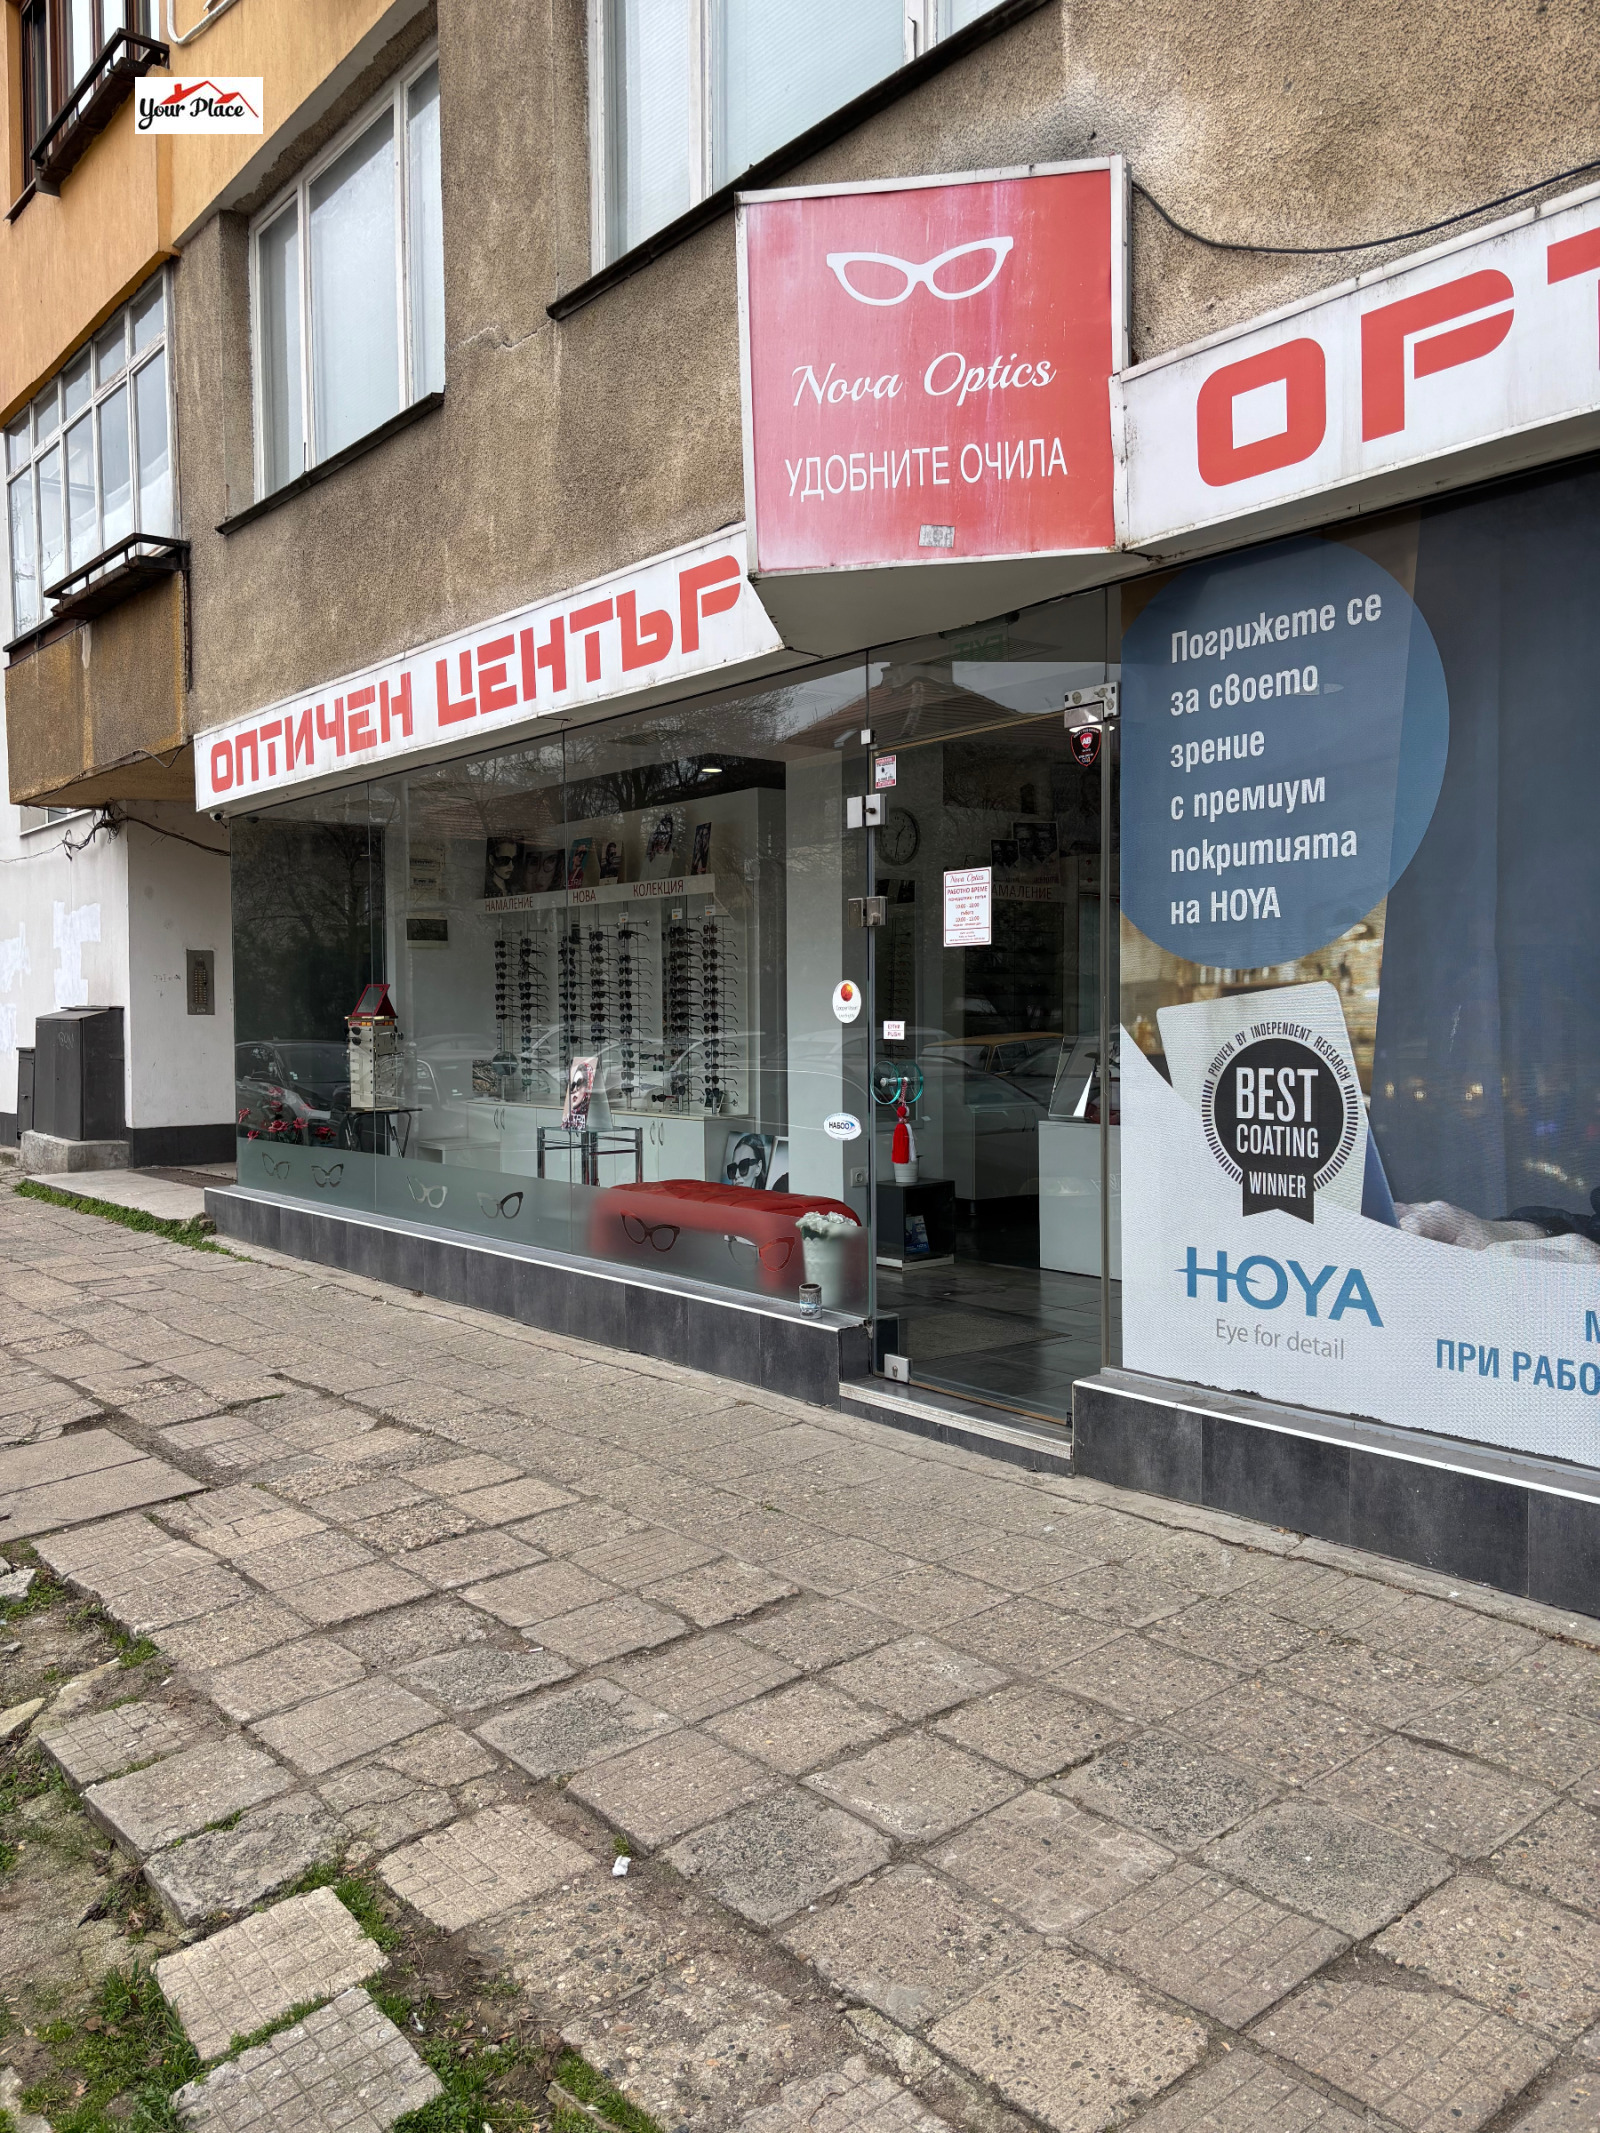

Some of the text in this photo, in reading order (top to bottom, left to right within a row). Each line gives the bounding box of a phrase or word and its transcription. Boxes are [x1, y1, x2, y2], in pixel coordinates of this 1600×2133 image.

[792, 352, 1056, 406] Nova Optics
[785, 437, 1068, 502] УДОБНИТЕ ОЧИЛА
[1171, 593, 1382, 664] Погрижете се
[210, 554, 741, 793] ОПТИЧЕН ЦЕНТЪР
[1170, 665, 1318, 716] за своето
[1170, 730, 1265, 773] зрение
[1170, 776, 1326, 822] с премиум
[1171, 830, 1358, 875] покритията
[485, 879, 684, 912] НАМАЛЕНИЕ НОВА КОЛЕКЦИЯ
[992, 884, 1052, 899] АМАЛЕНИЕ
[1171, 886, 1281, 925] на HOYA
[1208, 1021, 1351, 1081] PROVEN BY INDEPENDENT RESEARCH
[1236, 1067, 1319, 1123] BEST
[1236, 1123, 1319, 1159] COATING
[1249, 1170, 1307, 1199] WINNER
[1174, 1246, 1385, 1328] HOYA
[1216, 1318, 1345, 1360] Eye for detail
[1436, 1338, 1600, 1396] ПРИ РАБО
